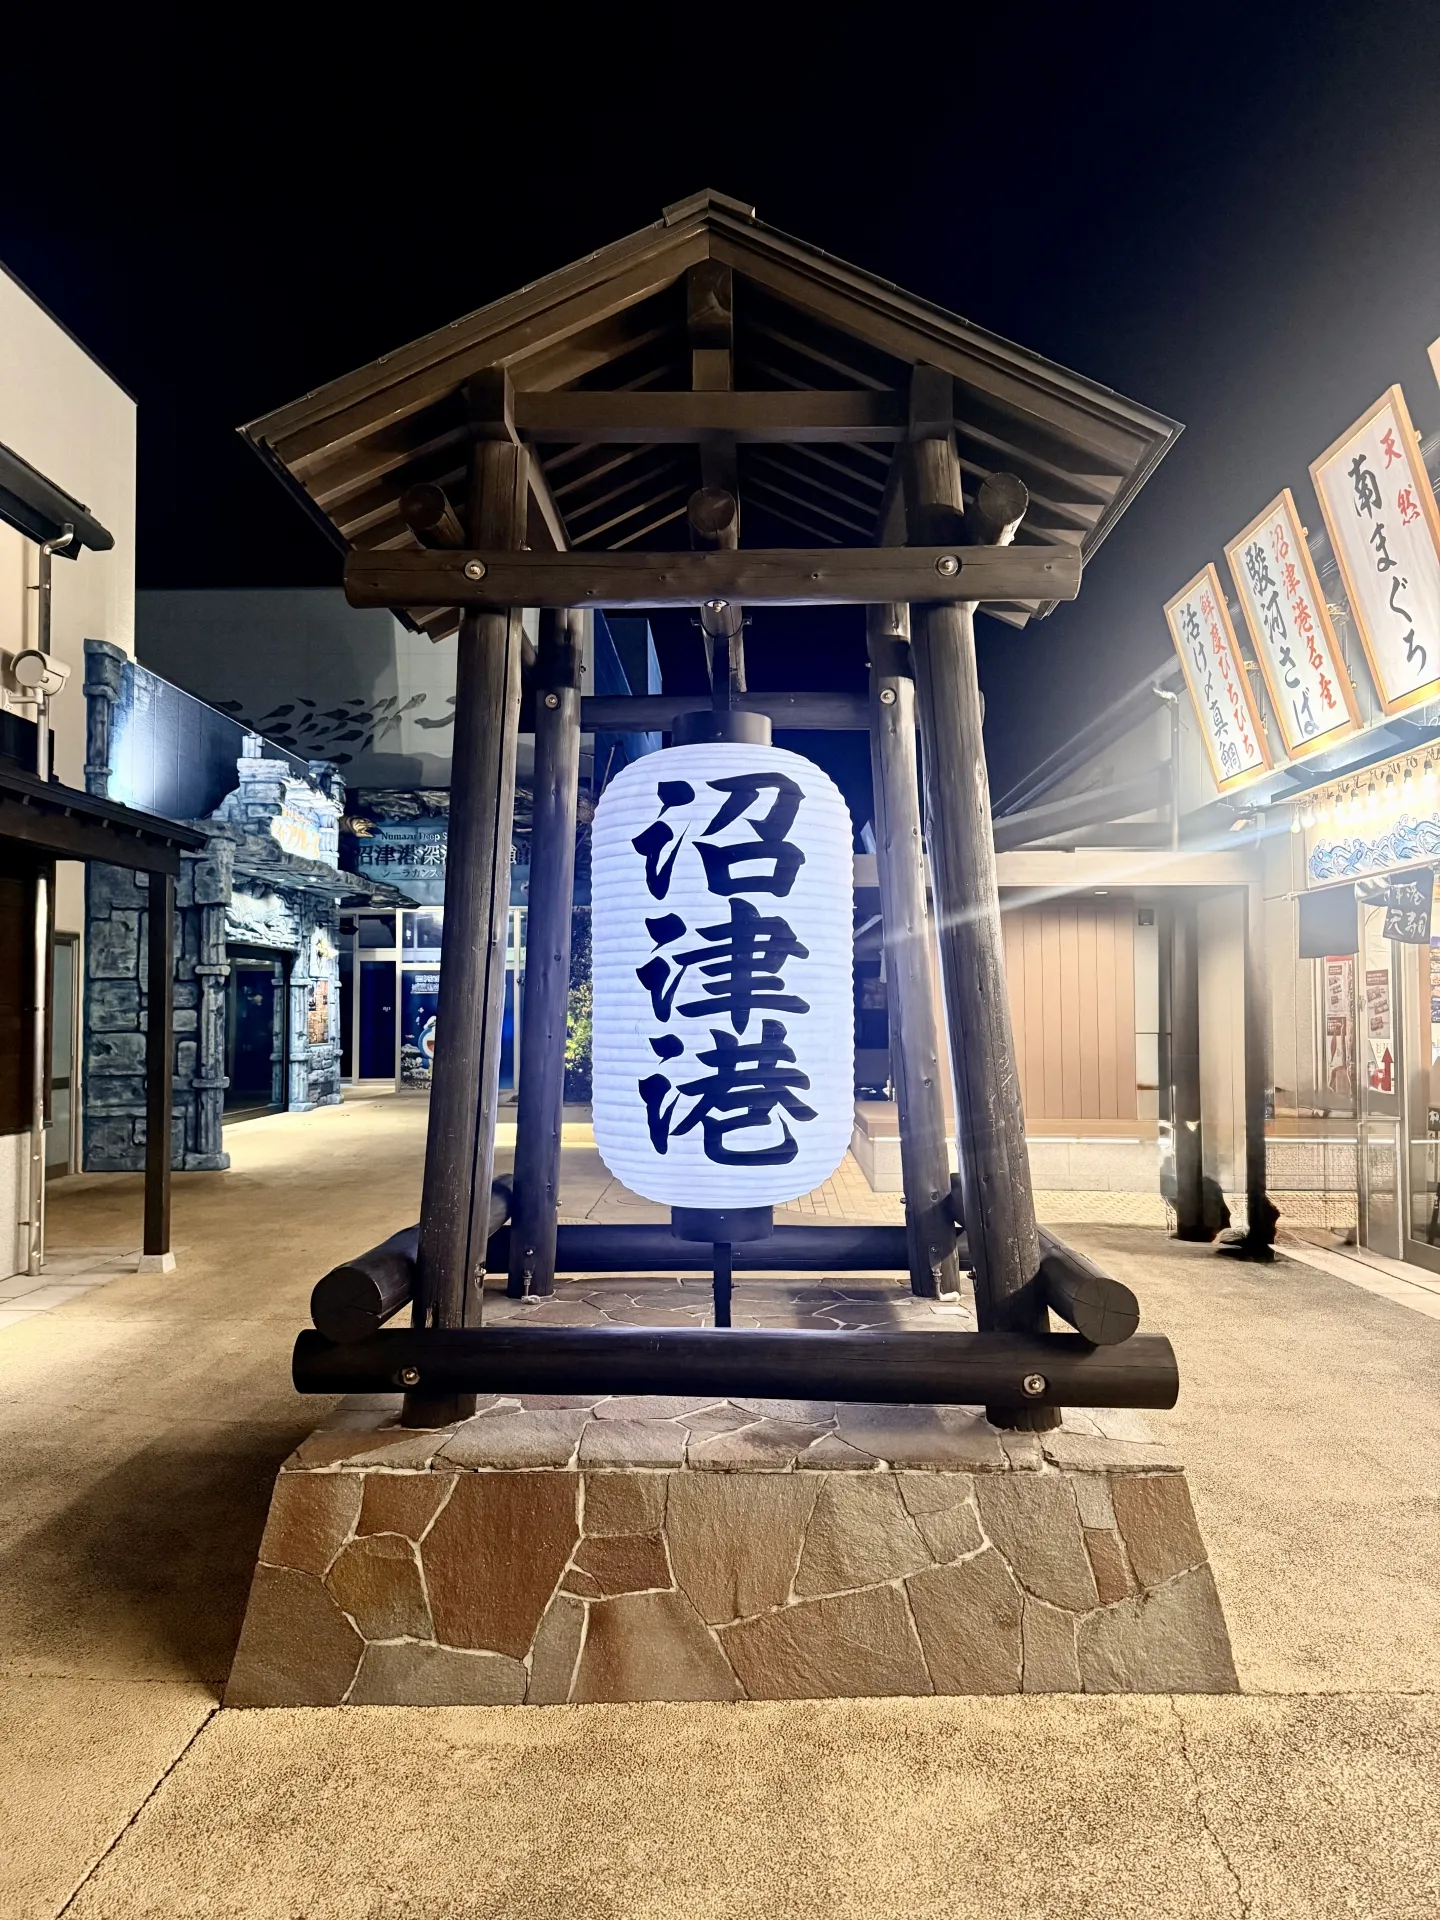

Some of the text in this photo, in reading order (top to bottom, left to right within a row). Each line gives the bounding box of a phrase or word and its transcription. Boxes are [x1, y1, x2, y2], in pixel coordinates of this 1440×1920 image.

[1379, 427, 1421, 526] 天然
[1245, 541, 1319, 738] 駿河さば
[1270, 523, 1337, 713] 沼津港名産
[381, 832, 417, 841] Numazu
[419, 832, 441, 842] Deep
[631, 771, 819, 1167] 沼津港
